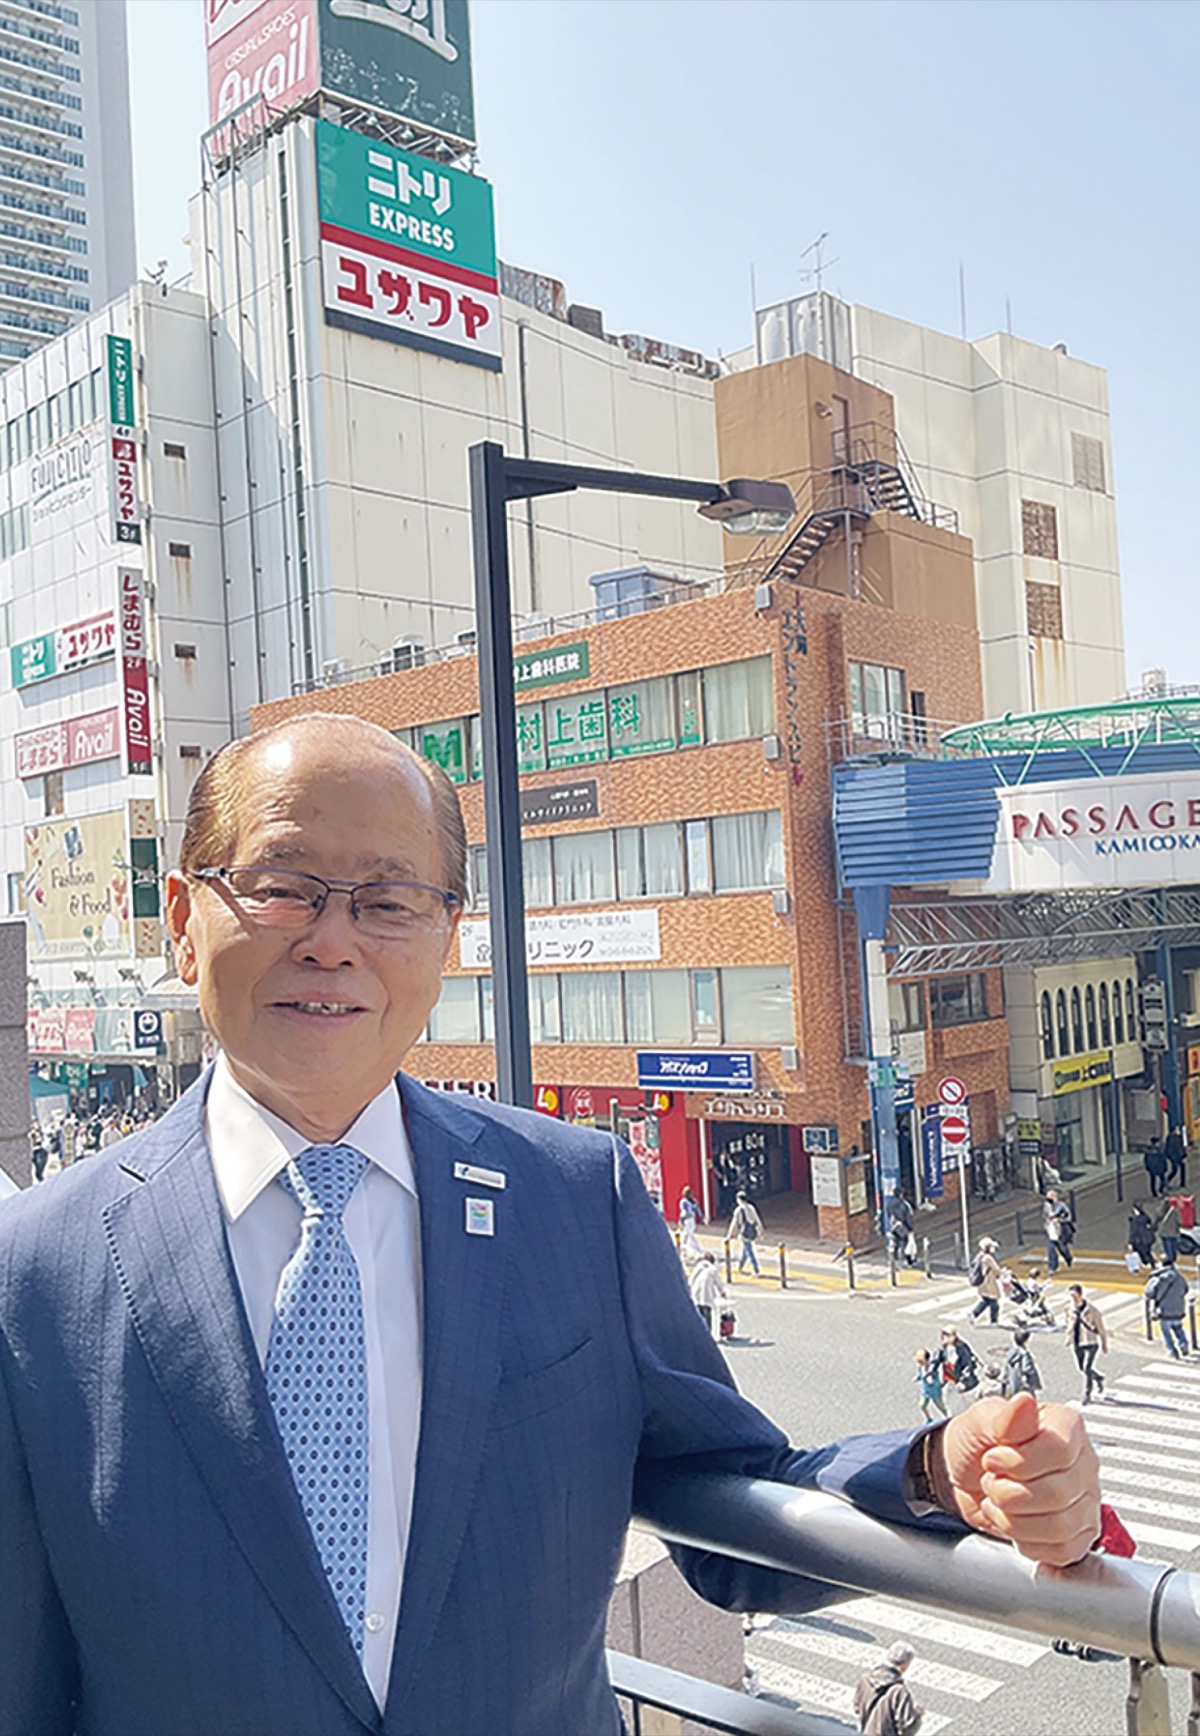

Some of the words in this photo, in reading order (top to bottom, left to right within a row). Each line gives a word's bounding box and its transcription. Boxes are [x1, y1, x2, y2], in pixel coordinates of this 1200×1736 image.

[217, 15, 310, 124] Avail
[368, 149, 452, 216] ニトリ
[369, 202, 456, 251] EXPRESS
[337, 256, 490, 339] ユザワヤ
[122, 574, 144, 651] しまむら
[127, 687, 149, 748] Avail
[517, 693, 640, 753] 村上歯科
[51, 859, 95, 889] Fashion
[81, 887, 112, 914] Food
